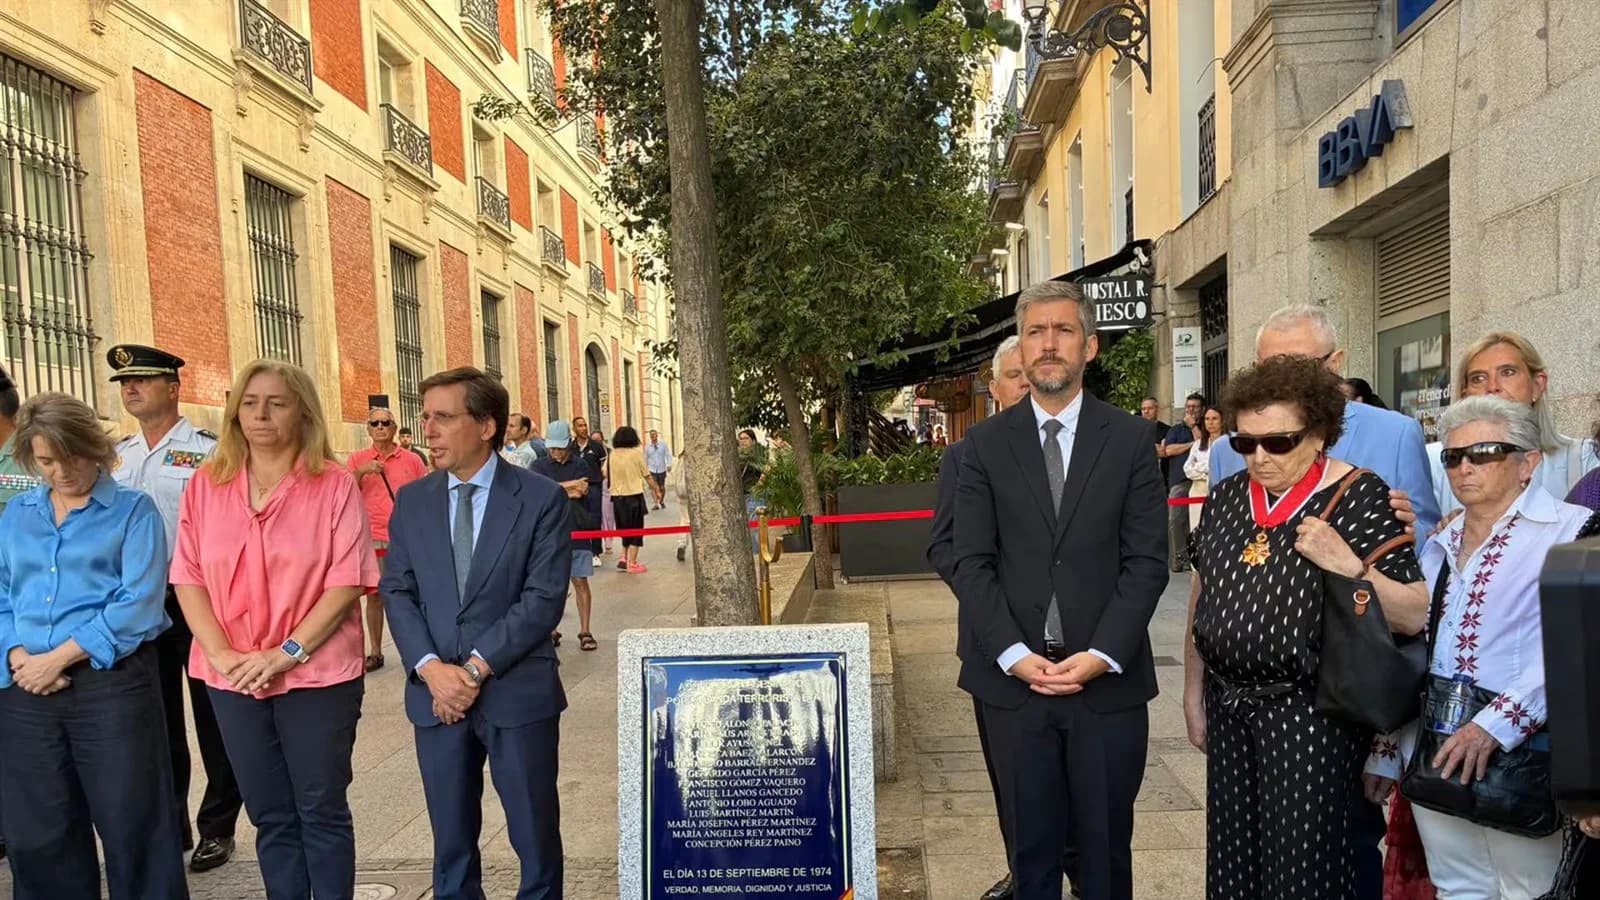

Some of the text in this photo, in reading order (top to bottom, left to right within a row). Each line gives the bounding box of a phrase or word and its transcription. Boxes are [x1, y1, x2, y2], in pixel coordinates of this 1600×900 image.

[1318, 79, 1414, 188] BBVA
[1083, 279, 1149, 300] HOSTAL R.
[1096, 301, 1147, 322] IESCO
[733, 767, 766, 777] GARCÍA
[769, 766, 797, 776] PÉREZ
[678, 777, 806, 788] FANCISCO GÓMEZ VAQUERO
[721, 789, 758, 798] LLANOS
[758, 788, 803, 797] GANCEDO
[688, 798, 797, 808] ANTONIO LOBO AGUADO
[689, 807, 794, 818] LUIS MARTÍNEZ MARTÍN
[667, 817, 816, 828] MARÍA JOSEFINA PÉREZ MARTÍNEZ
[672, 827, 813, 838] MARÍA ÁNGELES REY MARTÍNEZ
[685, 838, 801, 848] CONCEPCIÓN PÉREZ PAINO
[663, 867, 832, 879] EL DÍA 13 DE SEPTIEMBRE DE 1974
[745, 884, 786, 893] DIGNIDAD
[788, 884, 794, 893] Y
[795, 883, 832, 892] JUSTICIA
